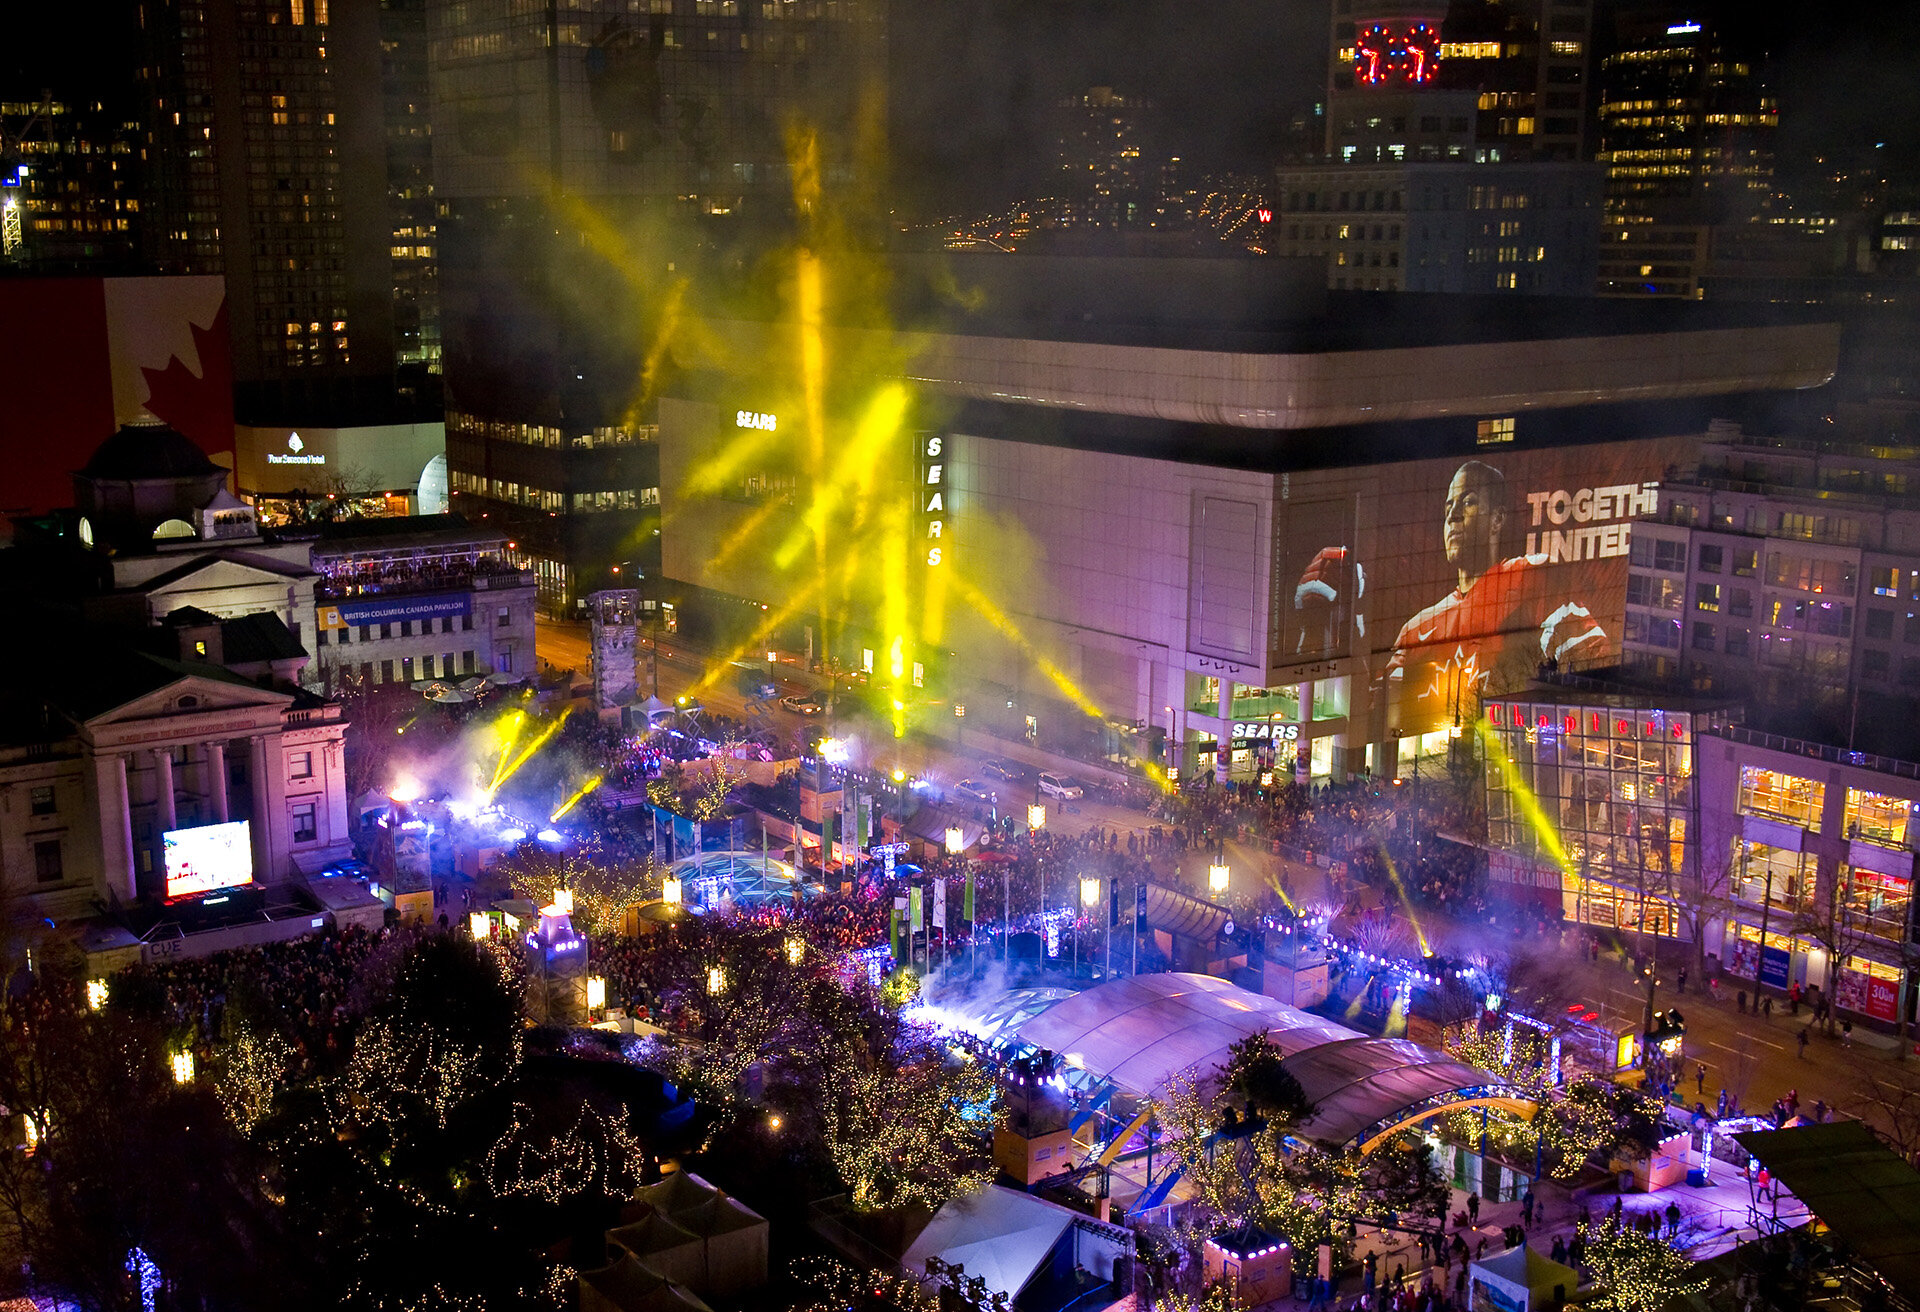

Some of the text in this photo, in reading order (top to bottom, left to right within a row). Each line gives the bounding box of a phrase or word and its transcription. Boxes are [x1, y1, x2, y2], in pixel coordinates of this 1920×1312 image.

[1258, 209, 1272, 223] W
[736, 410, 777, 431] SEARS
[926, 437, 943, 566] SEARS
[1526, 523, 1632, 564] UNITED
[344, 601, 464, 620] BRITISH COLUMBIA CANADA PAVILION
[1489, 703, 1683, 738] Chapters
[1231, 723, 1299, 740] SEARS
[1489, 865, 1517, 884] MORE
